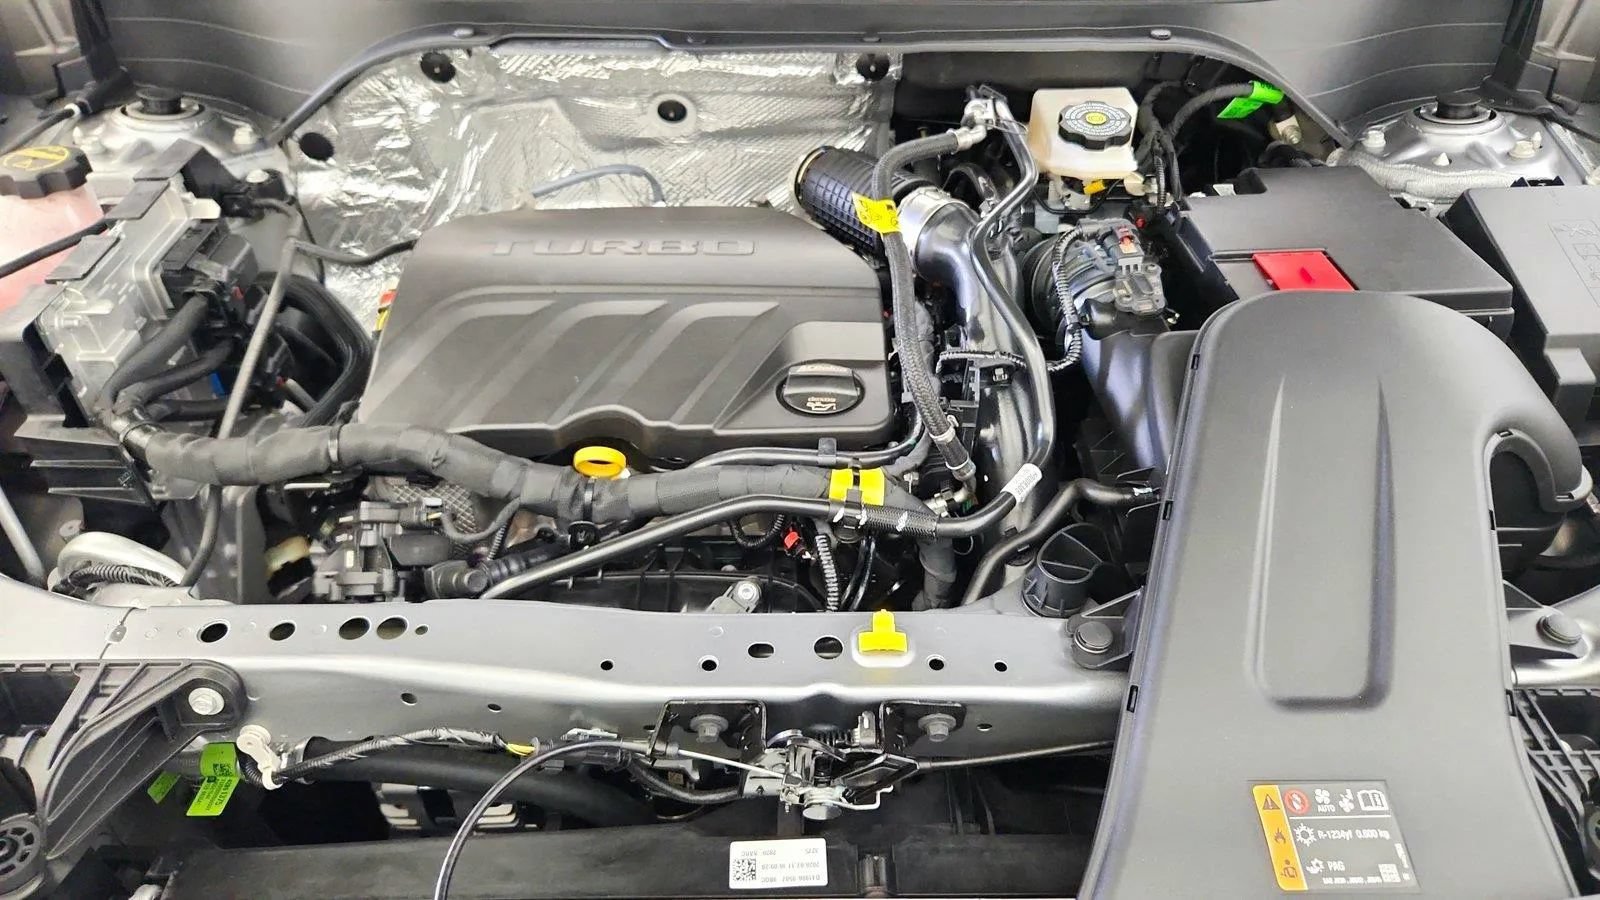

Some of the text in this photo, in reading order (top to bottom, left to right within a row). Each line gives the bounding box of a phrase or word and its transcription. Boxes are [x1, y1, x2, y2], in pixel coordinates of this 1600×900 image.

[489, 238, 757, 256] TURBO
[1317, 804, 1336, 813] AUTO
[1327, 860, 1346, 872] PAG
